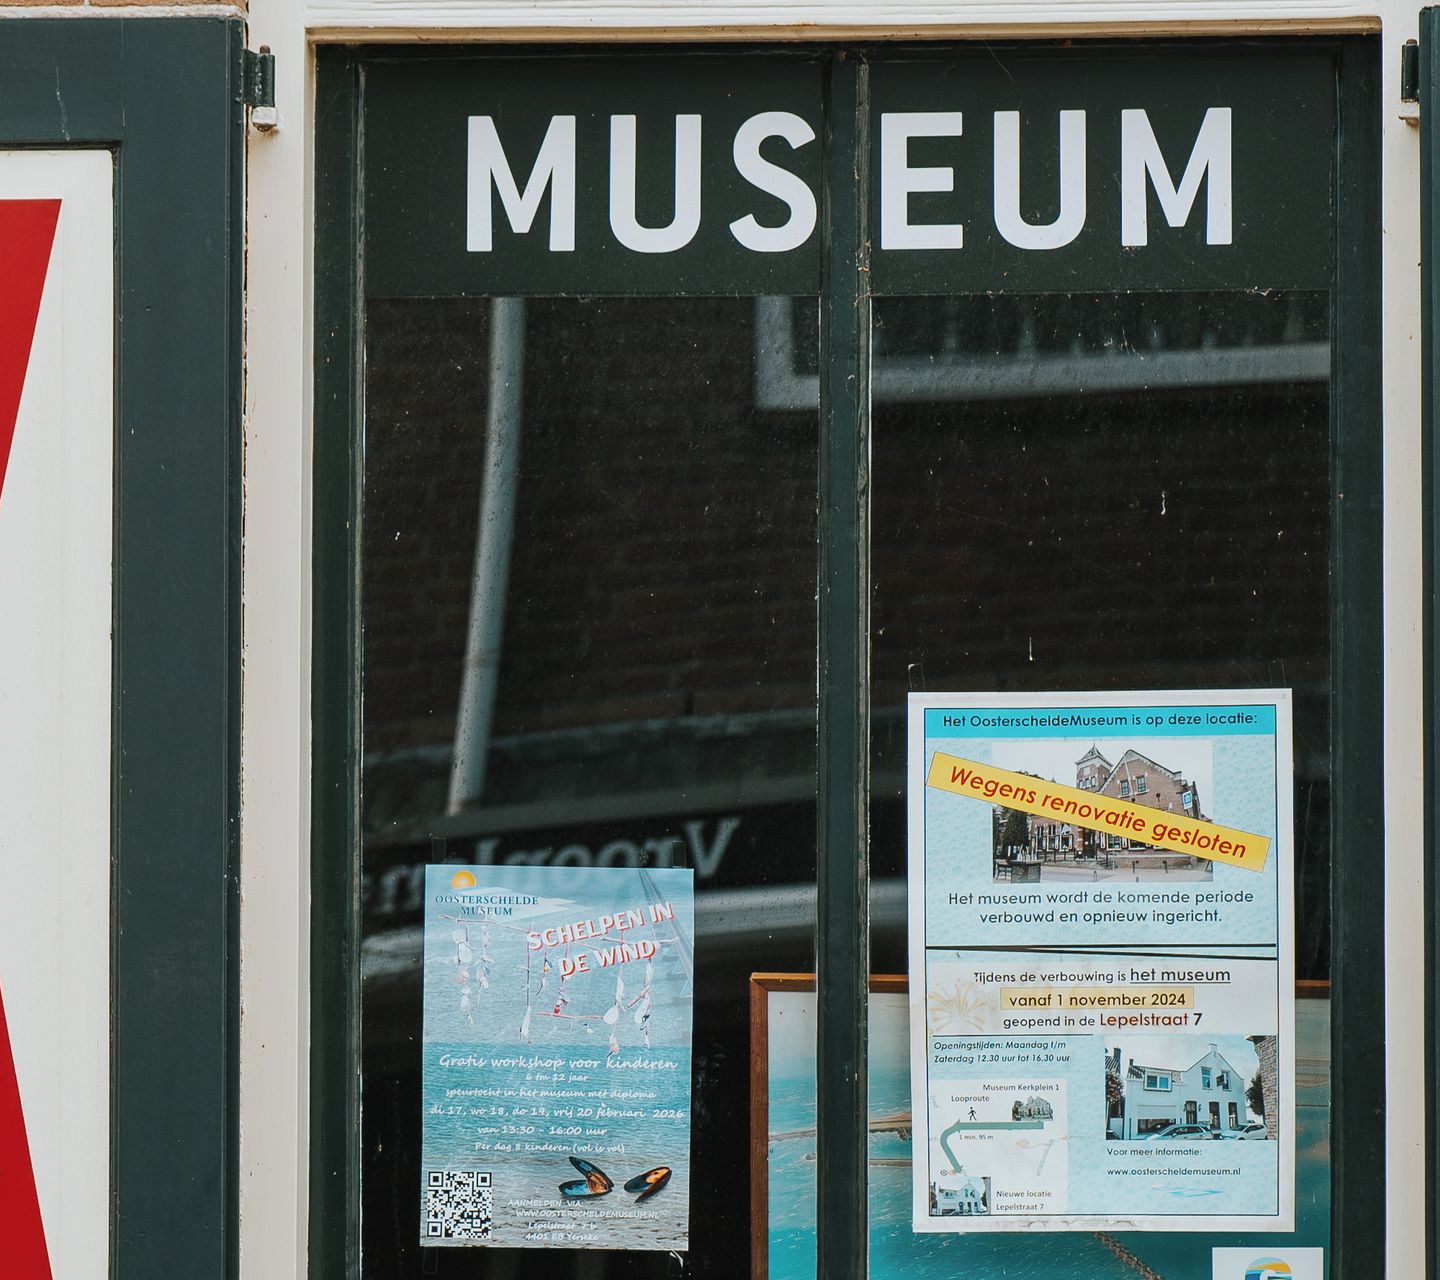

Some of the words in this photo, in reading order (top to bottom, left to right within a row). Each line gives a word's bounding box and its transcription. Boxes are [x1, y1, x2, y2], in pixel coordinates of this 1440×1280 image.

[467, 107, 1232, 253] MUSEUM
[943, 716, 966, 727] Het
[970, 714, 1128, 728] OosterscheldeMuseum
[1132, 714, 1142, 725] is
[1146, 716, 1164, 728] op
[1168, 713, 1202, 725] deze
[1206, 712, 1258, 724] locatie:
[950, 766, 1037, 804] Wegens
[1041, 793, 1147, 833] renovatie
[1151, 822, 1248, 858] gesloten
[435, 894, 539, 906] OOSTERSCHELDE
[948, 892, 974, 905] Het
[978, 894, 1042, 905] museum
[1046, 892, 1089, 904] wordt
[1092, 891, 1112, 904] de
[1118, 890, 1191, 904] komende
[1195, 890, 1254, 906] periode
[461, 906, 513, 916] MUSEUM
[979, 910, 1056, 924] verbouwd
[1060, 912, 1078, 922] en
[1083, 910, 1147, 925] opnieuw
[1152, 909, 1222, 925] ingericht.
[527, 908, 646, 951] SCHELPEN
[648, 902, 675, 924] IN
[557, 954, 590, 978] DE
[592, 940, 657, 968] WIND
[974, 971, 1016, 984] Tijdens
[1019, 971, 1037, 983] de
[1040, 971, 1114, 985] verbouwing
[1117, 971, 1127, 982] is
[1130, 968, 1156, 982] het
[1160, 969, 1232, 982] museum
[1009, 994, 1052, 1006] vanaf
[1057, 994, 1063, 1006] 1
[1070, 993, 1148, 1006] november
[1151, 993, 1186, 1006] 2024
[1003, 1016, 1060, 1029] geopend
[1064, 1016, 1075, 1027] in
[1078, 1016, 1096, 1027] de
[1100, 1012, 1188, 1030] Lepelstraat
[1193, 1013, 1203, 1026] 7
[934, 1041, 1004, 1050] Openingstijden:
[1006, 1042, 1048, 1050] Maandag
[1050, 1041, 1066, 1049] t/m
[439, 1054, 488, 1068] Gratis
[491, 1055, 566, 1072] workshop
[569, 1059, 602, 1068] voor
[606, 1056, 678, 1069] kinderen
[934, 1054, 974, 1064] Zaterdag
[977, 1054, 1000, 1063] 12.30
[1017, 1054, 1030, 1062] tot
[1032, 1054, 1054, 1062] 16.30
[568, 1072, 589, 1083] jaar
[1018, 1084, 1054, 1092] Kerkplein
[446, 1088, 502, 1098] speurtocht
[504, 1088, 518, 1096] in
[520, 1088, 538, 1097] het
[540, 1090, 586, 1098] museum
[588, 1090, 608, 1098] met
[610, 1089, 657, 1100] diploma
[951, 1095, 990, 1103] Looproute
[430, 1105, 445, 1114] di
[448, 1106, 467, 1116] 17,
[490, 1107, 508, 1116] 18,
[512, 1106, 528, 1115] do
[530, 1107, 550, 1117] 19,
[554, 1106, 574, 1118] vrij
[576, 1108, 593, 1117] 20
[595, 1106, 646, 1120] februari
[652, 1109, 684, 1118] 2026
[477, 1126, 500, 1134] van
[502, 1126, 535, 1134] 13:30
[549, 1126, 582, 1135] 16:00
[586, 1128, 608, 1136] uur
[476, 1142, 491, 1151] Per
[494, 1142, 512, 1152] dag
[525, 1142, 572, 1152] kinderen
[572, 1144, 593, 1154] (vol
[595, 1144, 606, 1152] is
[607, 1144, 625, 1154] vol)
[1107, 1148, 1128, 1156] Voor
[1155, 1148, 1202, 1156] informatie:
[1107, 1168, 1241, 1176] www.oosterscheldemuseum.nl
[996, 1190, 1025, 1198] Nieuwe
[1026, 1190, 1052, 1198] locatie
[508, 1199, 562, 1208] AANMELDEN
[567, 1200, 584, 1208] VIA:
[996, 1204, 1038, 1212] Lepelstraat
[515, 1209, 659, 1220] WWW.OOSTERSCHELDEMUSEUM.NL
[528, 1222, 577, 1231] Lepelstraat
[566, 1232, 600, 1241] Yerseke
